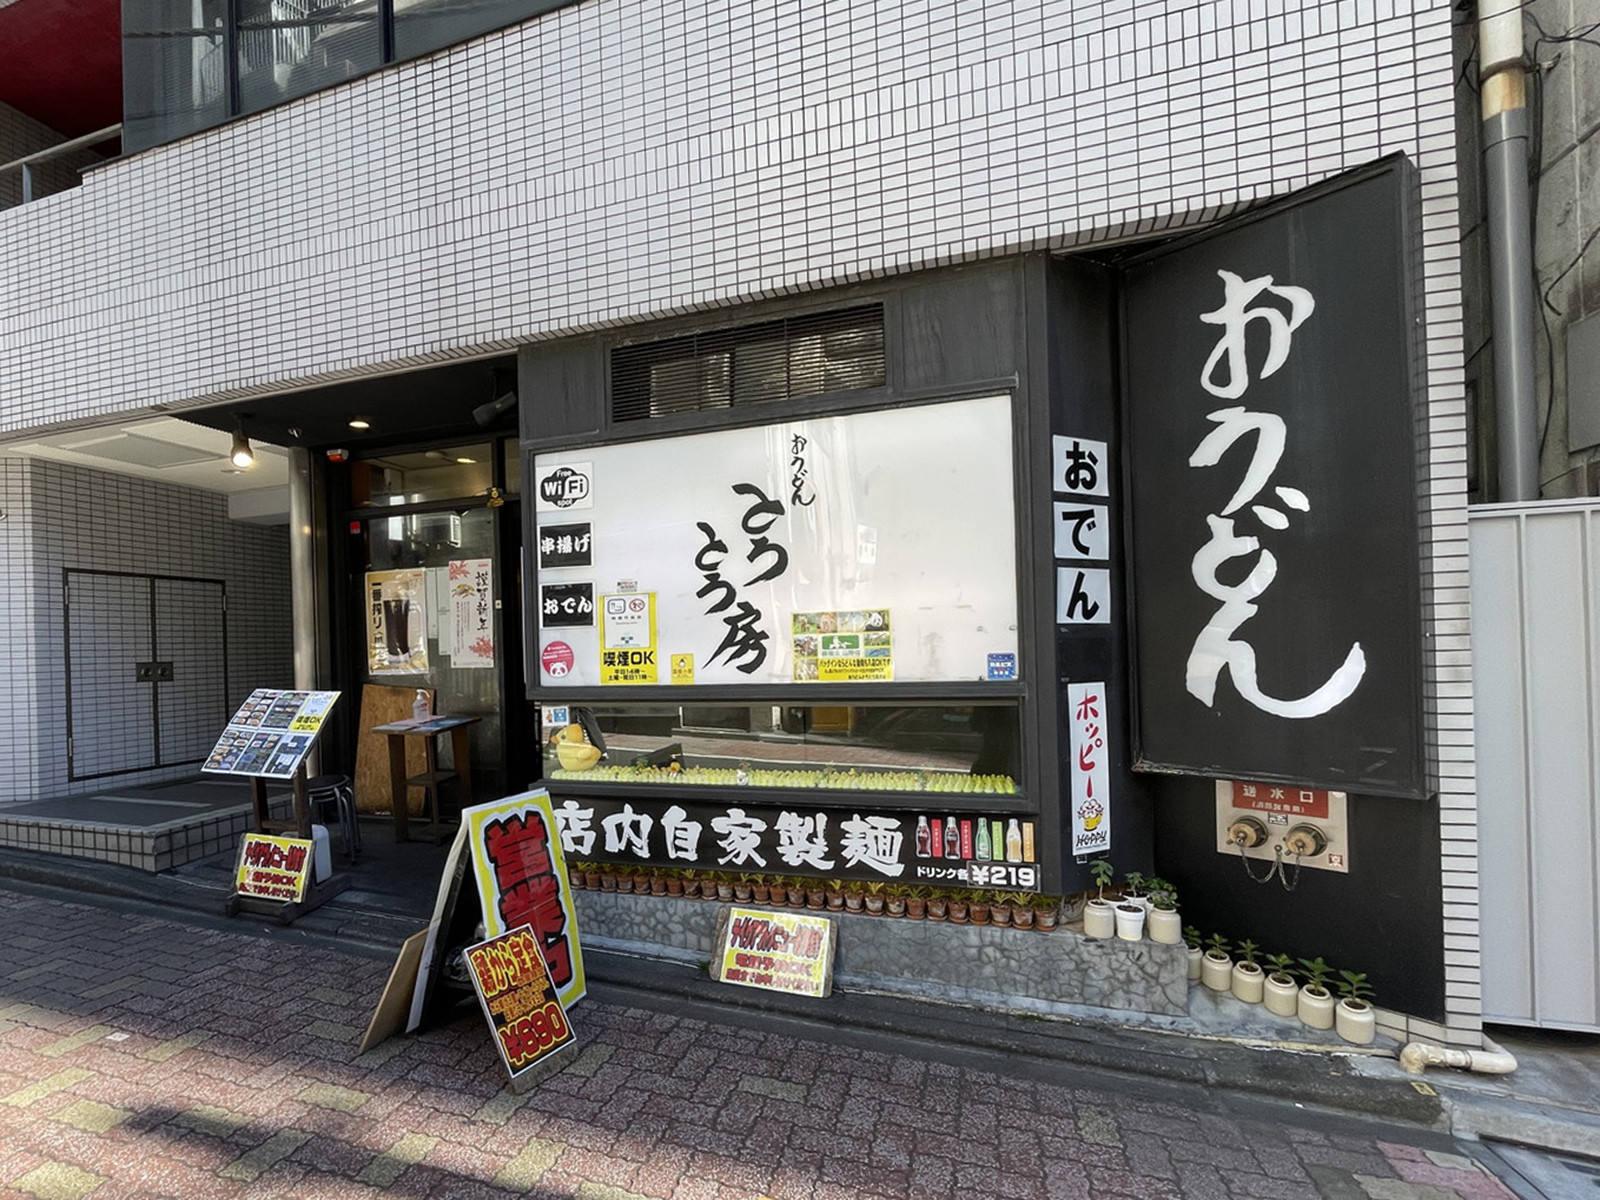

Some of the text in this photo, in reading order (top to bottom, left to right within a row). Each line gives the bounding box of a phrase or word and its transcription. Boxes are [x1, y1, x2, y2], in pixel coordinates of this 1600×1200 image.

[556, 470, 573, 478] Free
[790, 433, 816, 506] おうどん
[1186, 269, 1366, 719] おうどん
[1062, 441, 1100, 620] おでん
[541, 533, 591, 555] 串揚げ
[543, 596, 593, 614] おでん
[603, 651, 655, 666] 喫煙OK
[1076, 688, 1103, 798] ホッピー
[1242, 784, 1314, 803] 送水口
[553, 800, 905, 877] 店内自家製麺
[971, 864, 1035, 887] ¥219
